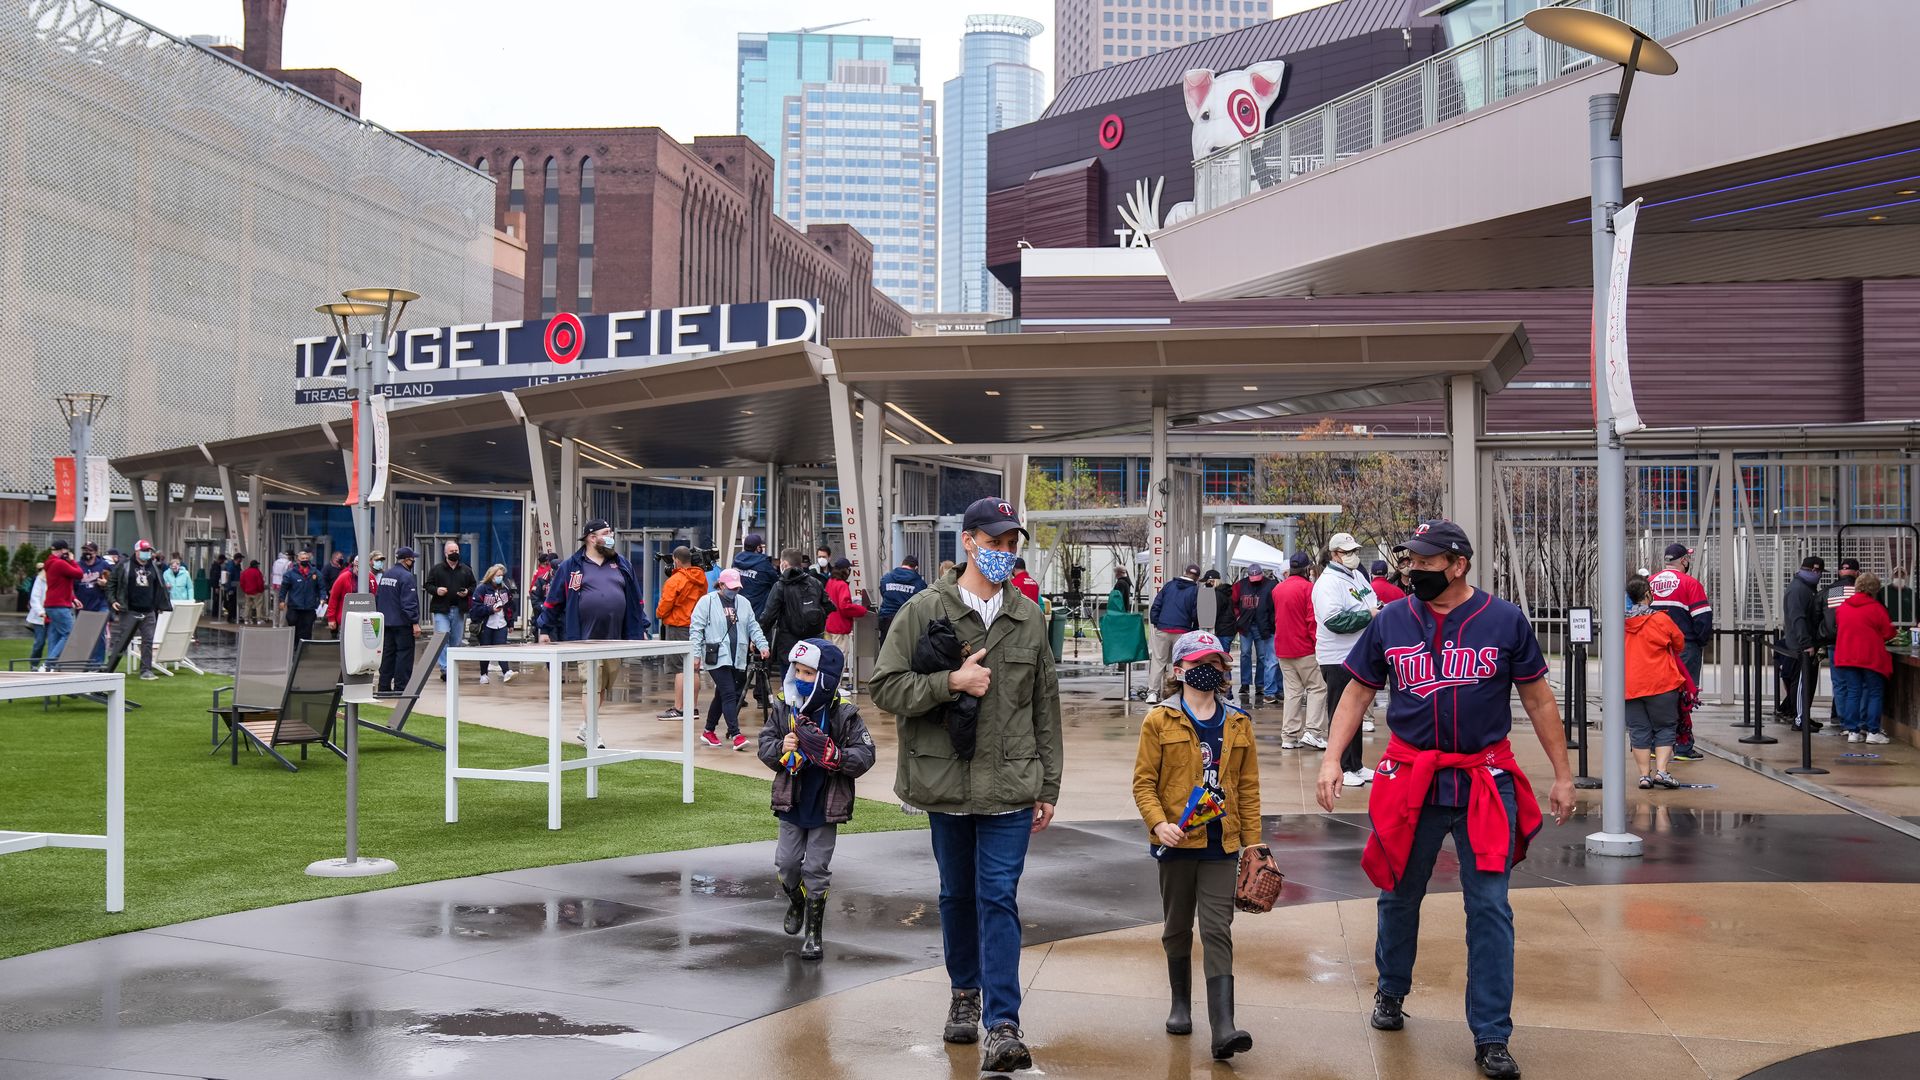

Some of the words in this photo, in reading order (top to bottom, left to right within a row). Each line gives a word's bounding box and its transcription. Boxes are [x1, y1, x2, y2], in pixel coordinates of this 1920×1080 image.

[1114, 229, 1154, 248] TA
[608, 298, 816, 359] FIELD
[303, 389, 360, 402] TREAS
[380, 383, 434, 398] ISLAND
[62, 463, 71, 496] LAWN
[846, 507, 855, 525] NO
[1154, 510, 1163, 529] NO
[543, 521, 550, 536] NO
[849, 532, 863, 596] RE-ENTR
[1154, 536, 1162, 593] RE-ENT
[885, 582, 915, 594] SECURITY
[1651, 579, 1679, 593] Twins
[1384, 640, 1499, 698] Twins
